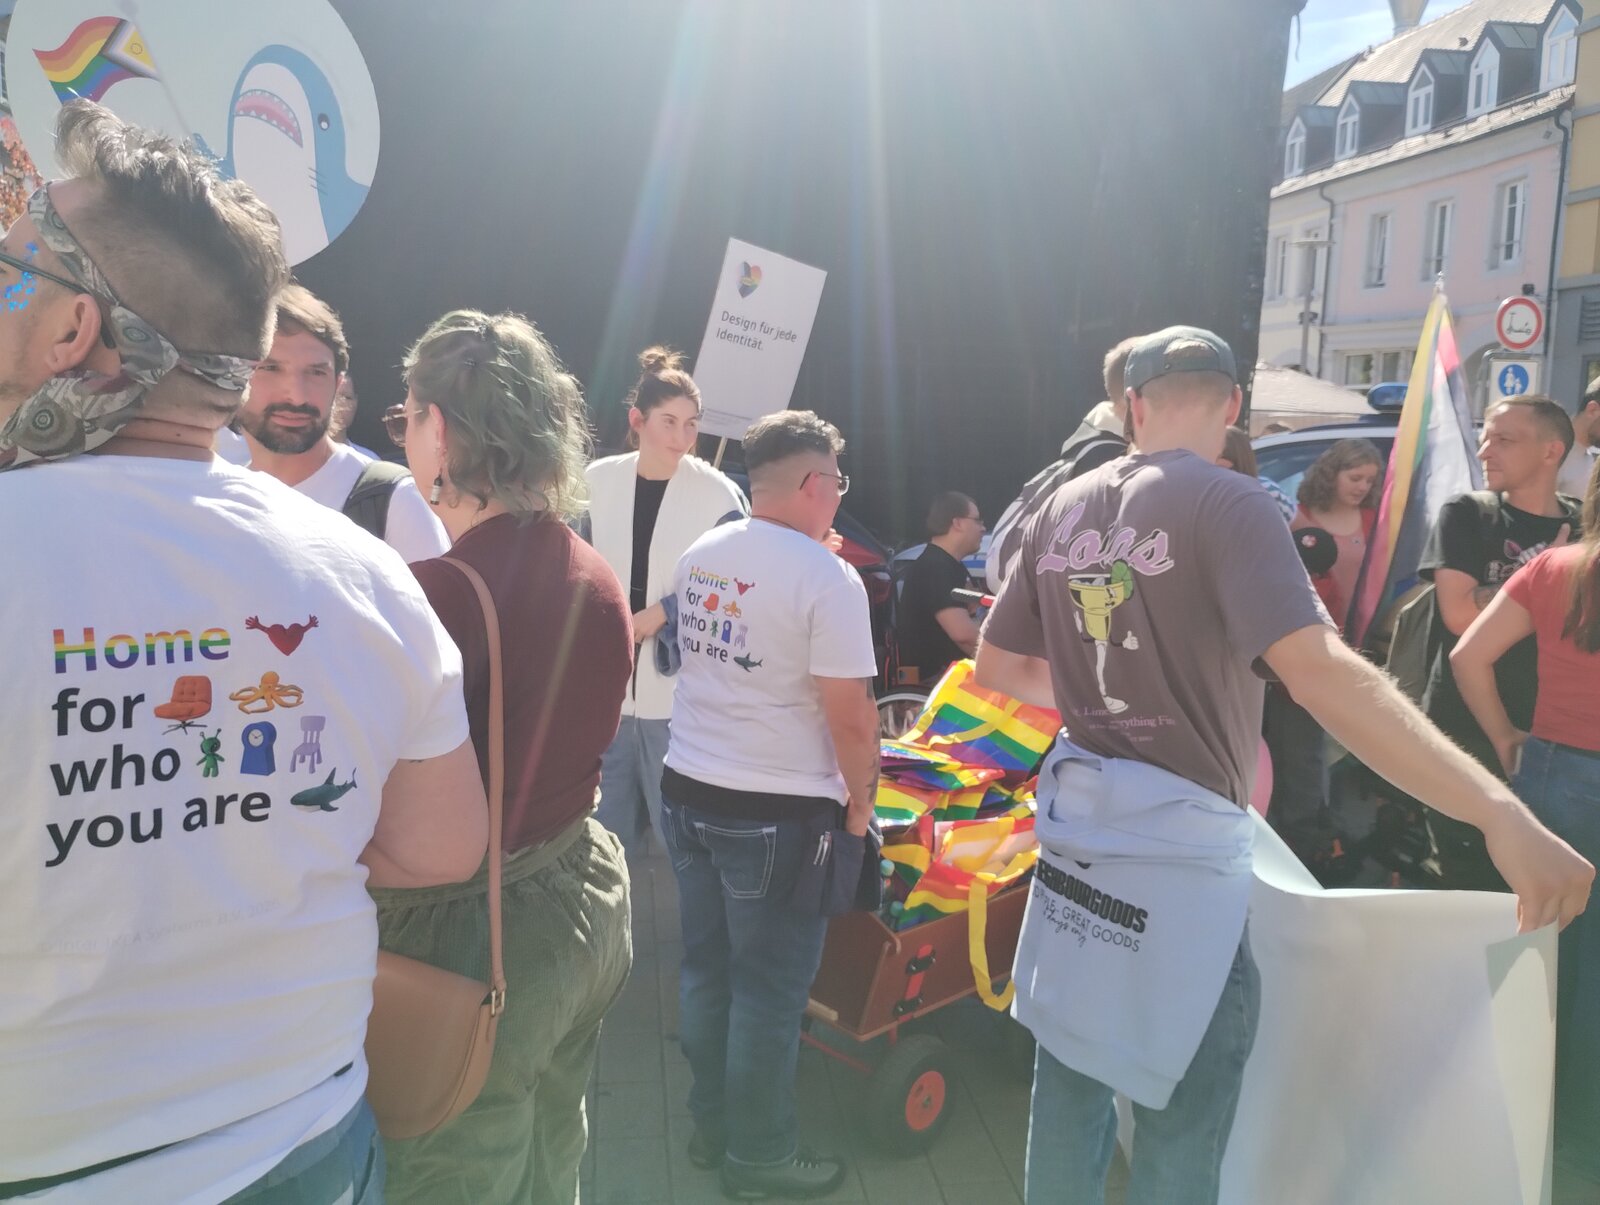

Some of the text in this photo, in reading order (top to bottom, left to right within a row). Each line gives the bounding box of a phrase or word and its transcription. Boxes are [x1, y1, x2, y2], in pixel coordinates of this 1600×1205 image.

[721, 310, 798, 343] Design für jede
[686, 586, 703, 607] for
[688, 565, 729, 591] Home
[681, 610, 707, 632] who
[52, 627, 232, 675] Home
[682, 633, 729, 663] you are
[51, 687, 146, 737] for
[50, 743, 182, 797] who
[45, 791, 272, 868] you are
[1062, 905, 1092, 932] GREAT
[1091, 924, 1141, 953] GOODS
